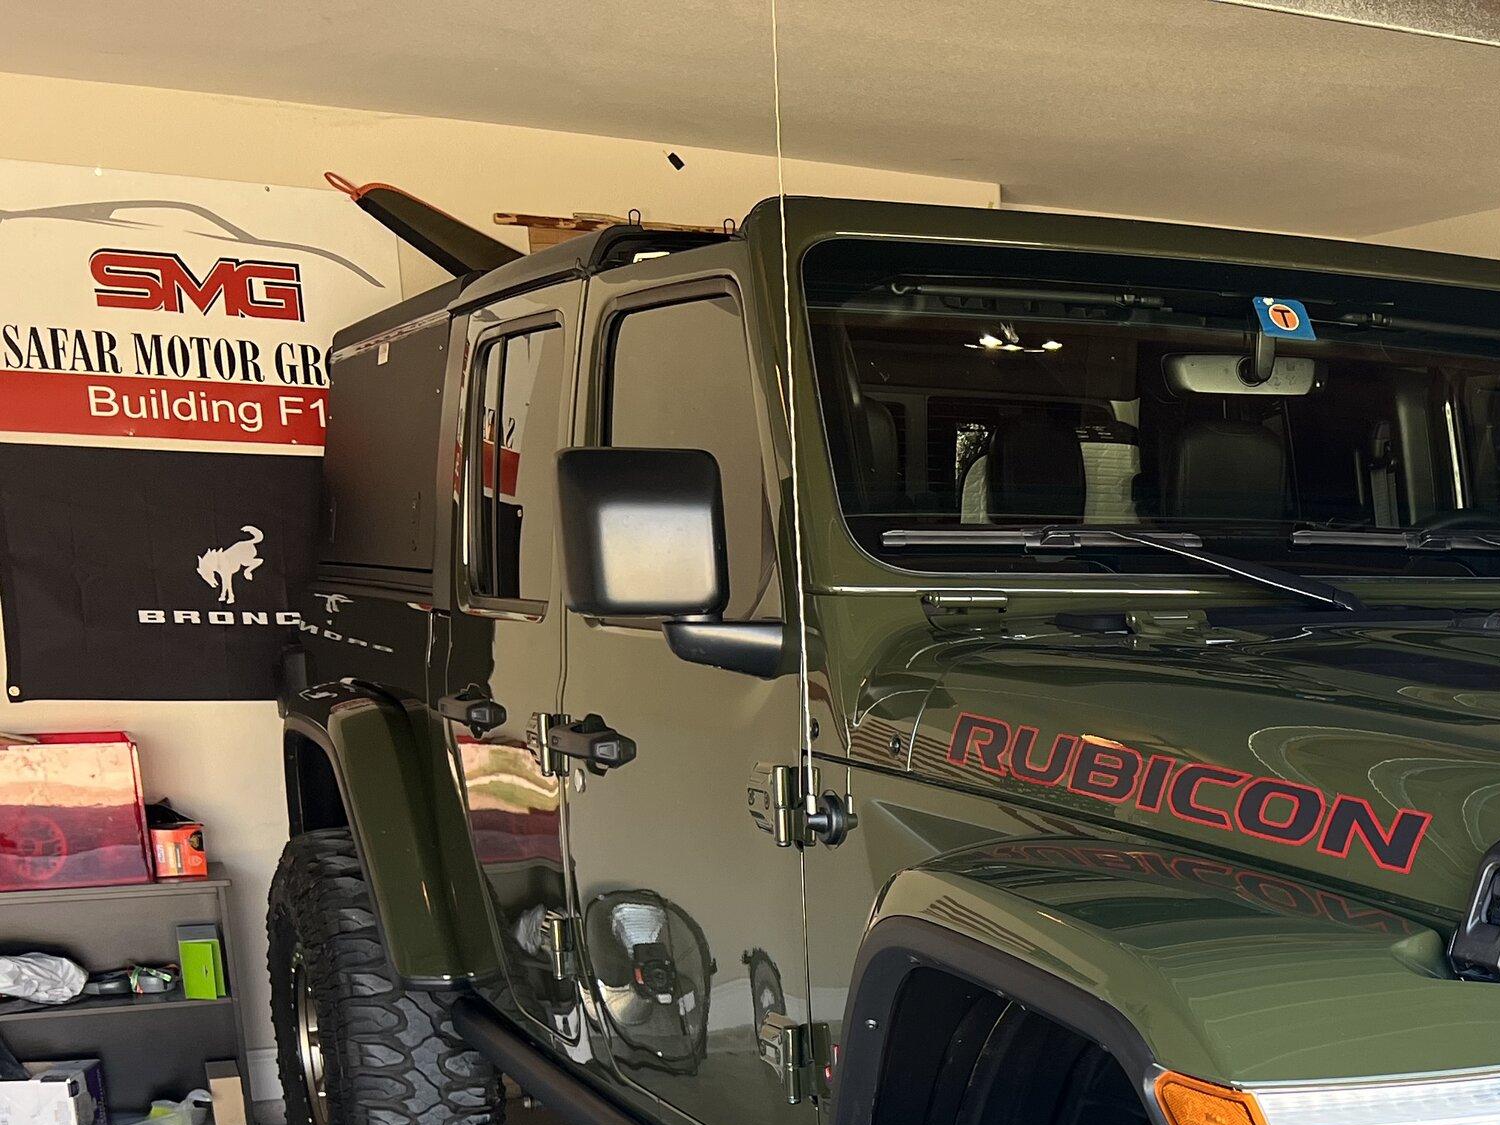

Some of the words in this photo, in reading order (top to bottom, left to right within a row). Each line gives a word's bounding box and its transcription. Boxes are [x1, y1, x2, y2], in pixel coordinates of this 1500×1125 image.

[88, 247, 305, 322] SMG
[1, 324, 123, 375] SAFAR
[131, 332, 266, 383] MOTOR
[87, 385, 264, 433] Building
[946, 711, 1434, 875] RUBICON
